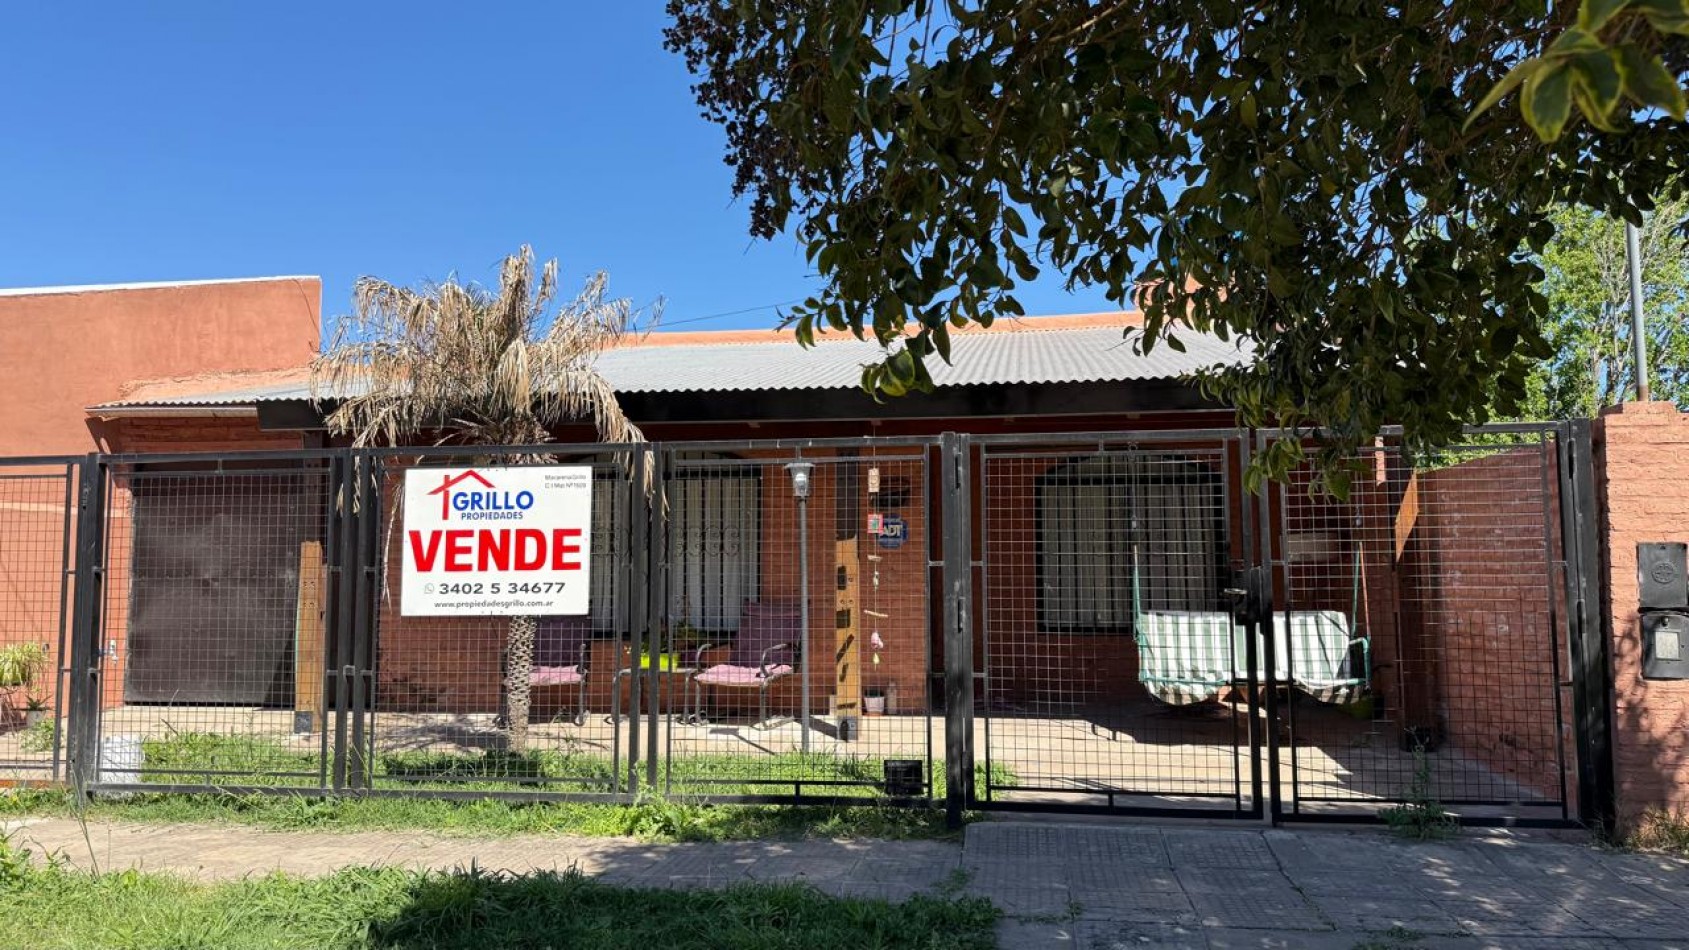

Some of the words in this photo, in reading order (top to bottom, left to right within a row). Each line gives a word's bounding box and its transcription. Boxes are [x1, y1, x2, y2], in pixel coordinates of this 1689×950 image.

[452, 490, 534, 511] GRILLO
[461, 511, 524, 521] PROPIEDADES
[880, 524, 903, 537] ADT
[408, 528, 583, 572] VENDE
[439, 583, 484, 595] 3402
[490, 583, 501, 595] 5
[507, 582, 566, 594] 34677
[434, 600, 554, 609] www.propiedadesgrillo.com.ar
